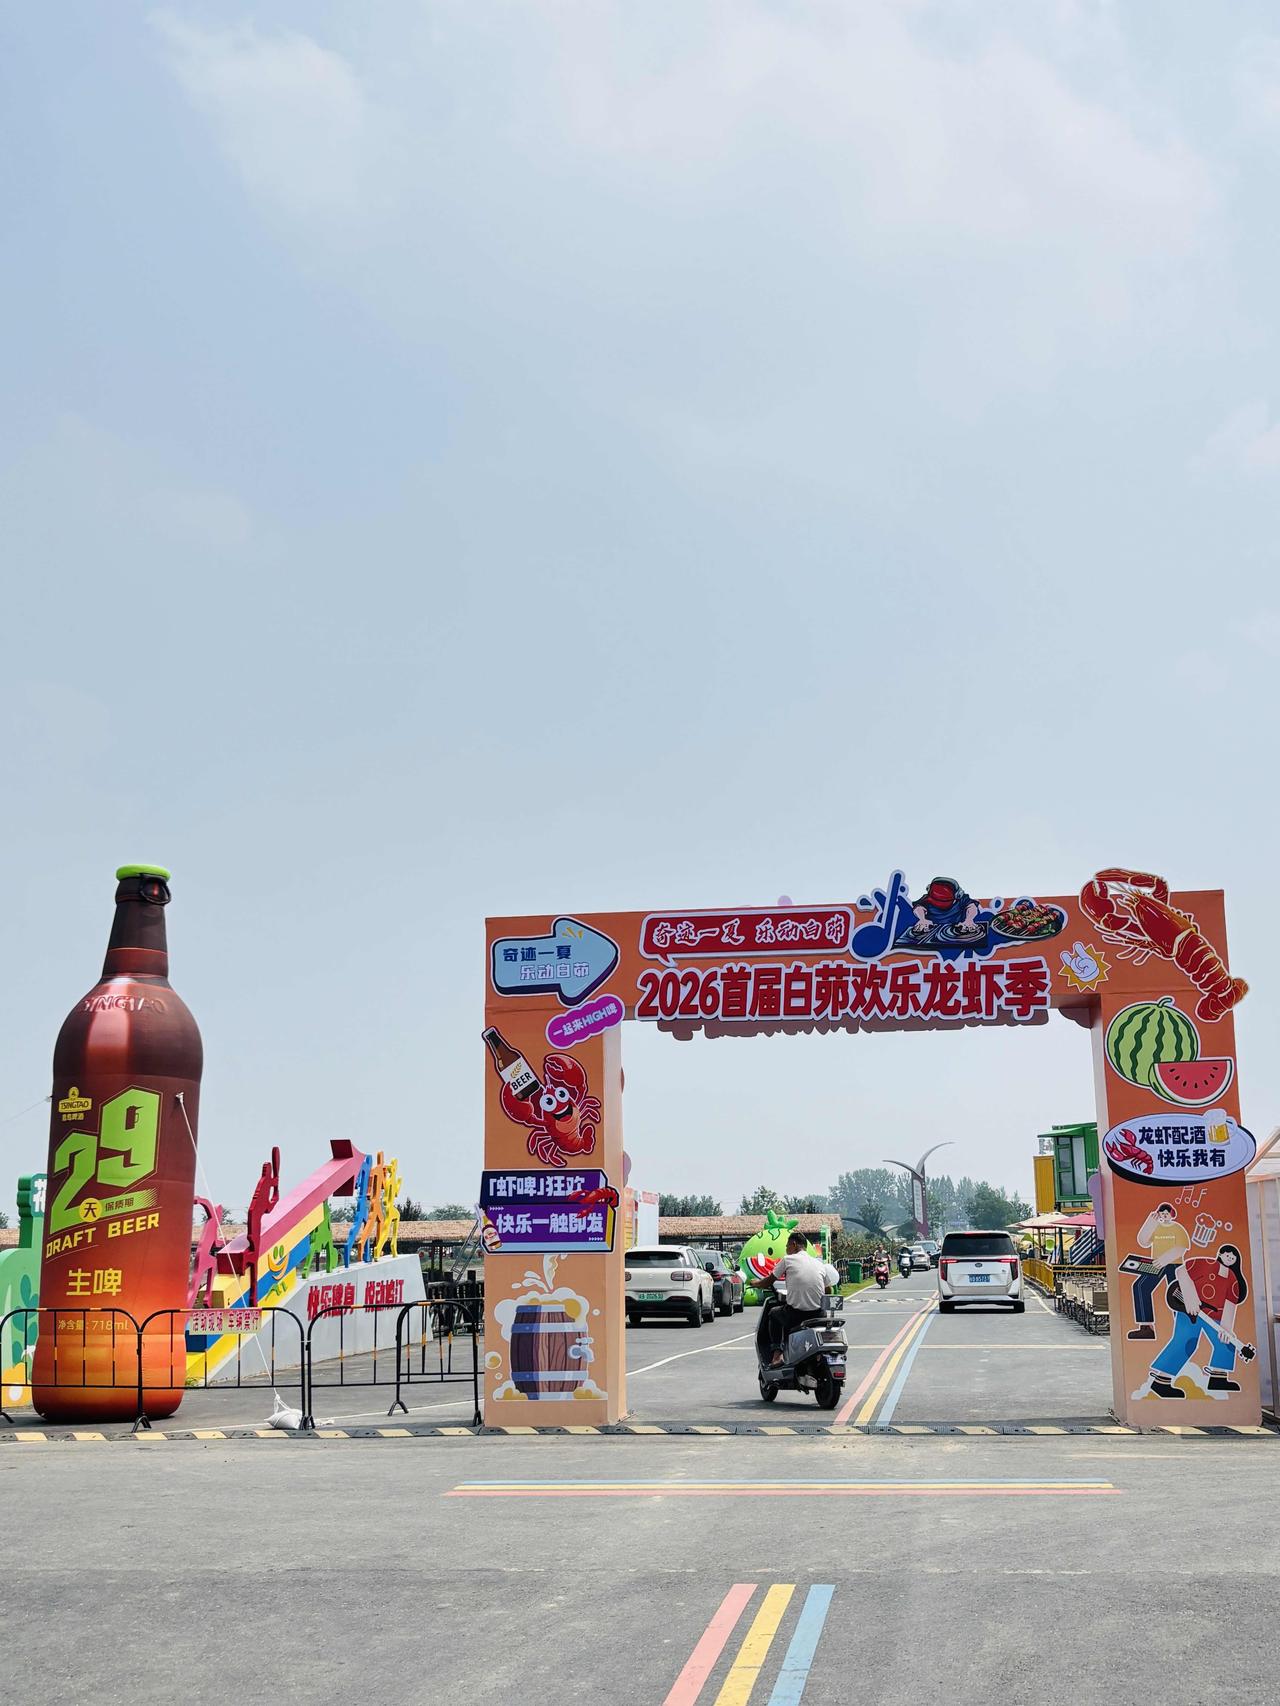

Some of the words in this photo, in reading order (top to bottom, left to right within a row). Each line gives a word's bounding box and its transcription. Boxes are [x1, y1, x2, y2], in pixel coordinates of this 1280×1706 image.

[503, 945, 571, 962] 奇迹一夏
[637, 959, 1049, 1017] 2026首届白茆欢乐龙虾季
[511, 1073, 532, 1091] BEER
[60, 1100, 90, 1110] TSINGTAO
[1138, 1126, 1206, 1145] 龙虾配酒
[50, 1088, 160, 1235] 29
[1158, 1148, 1225, 1168] 快乐我有
[83, 1202, 97, 1218] 天
[496, 1211, 604, 1234] 快乐一触即发
[45, 1227, 96, 1259] DRAFT
[107, 1212, 160, 1239] BEER
[66, 1267, 122, 1296] 生啤
